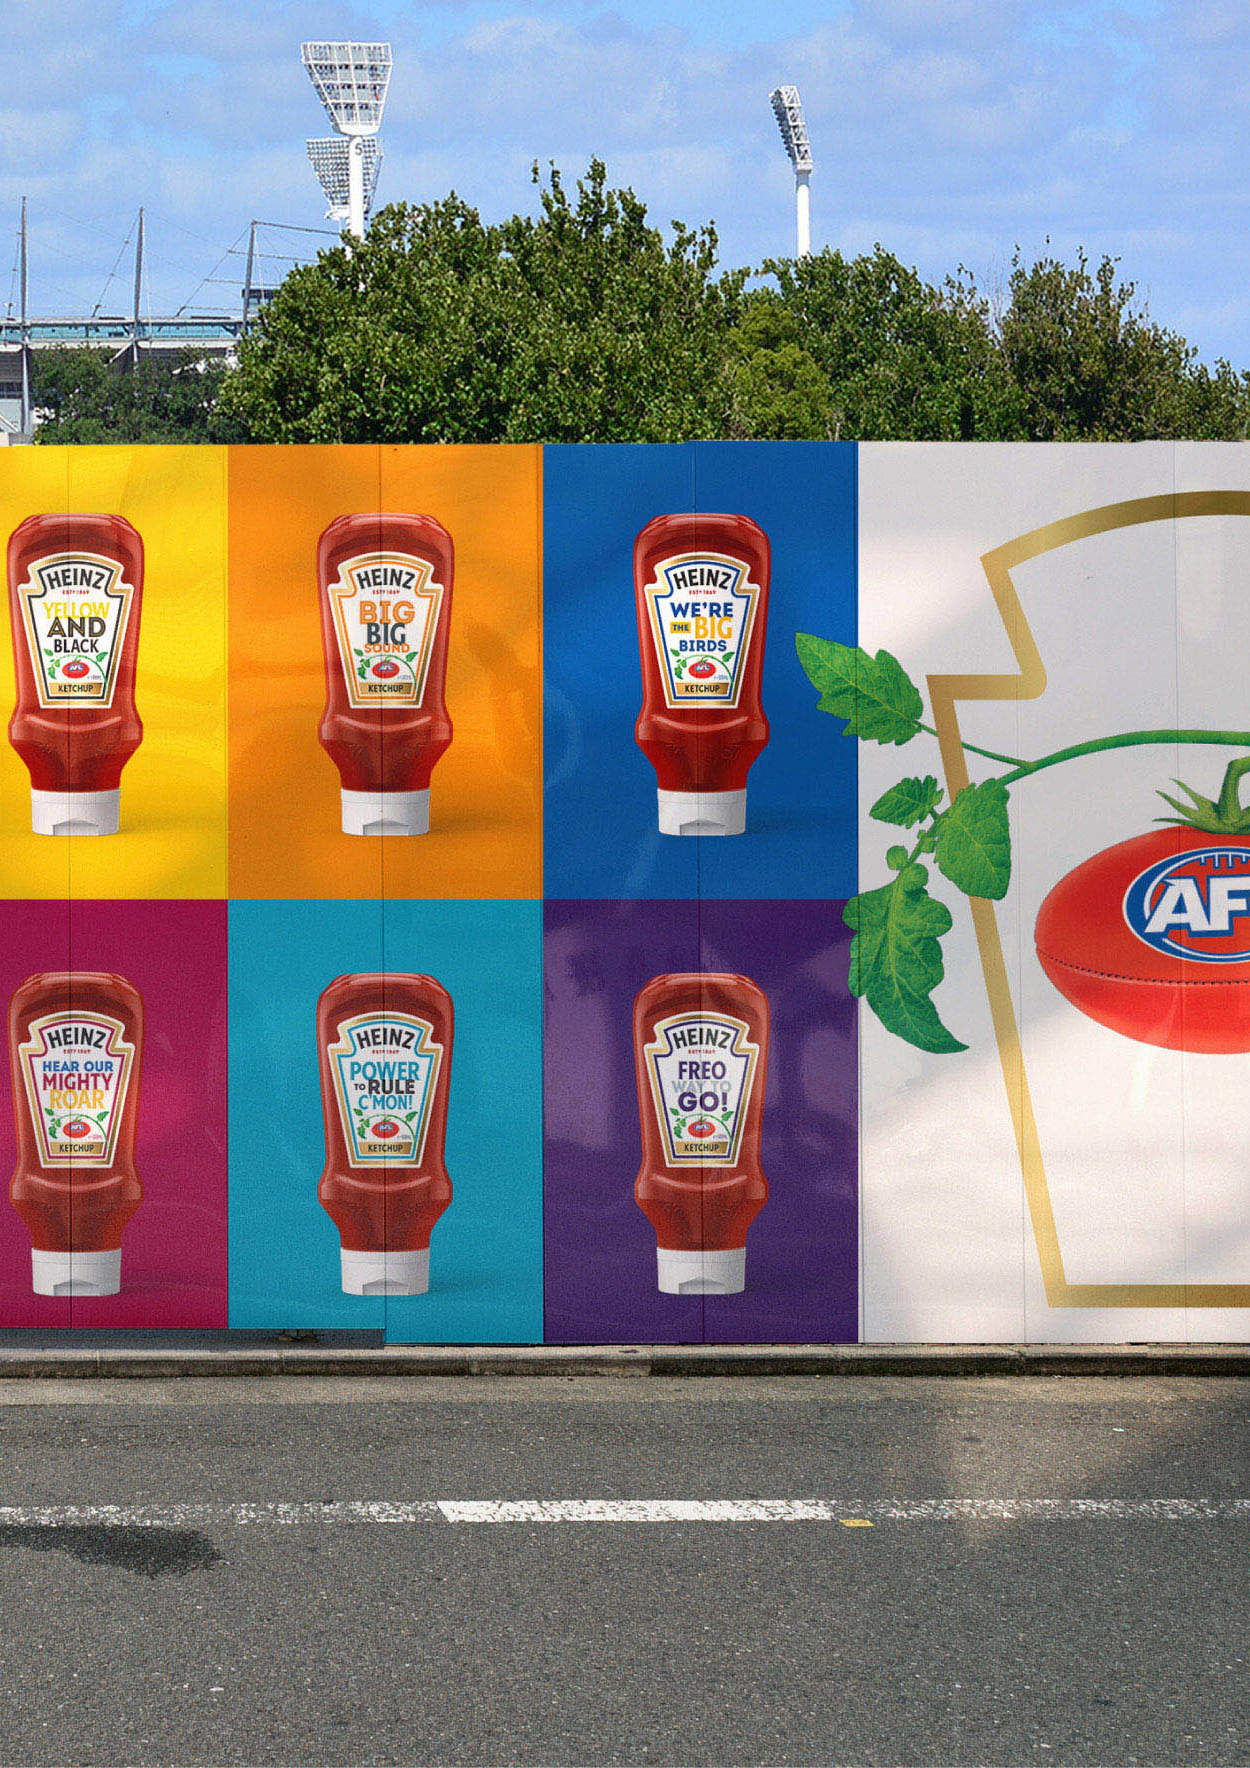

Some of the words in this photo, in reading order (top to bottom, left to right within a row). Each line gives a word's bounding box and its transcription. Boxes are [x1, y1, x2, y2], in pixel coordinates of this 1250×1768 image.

[355, 143, 363, 156] 5
[46, 568, 105, 589] HEINZ
[356, 568, 416, 589] HEINZ
[673, 568, 732, 589] HEINZ
[43, 602, 110, 619] YELLOW
[359, 601, 415, 624] BIG
[670, 602, 733, 618] WE'RE
[47, 617, 106, 637] AND
[367, 622, 406, 645] BIG
[695, 617, 732, 639] BIG
[54, 639, 99, 653] BLACK
[364, 643, 410, 653] SOUND
[679, 640, 727, 652] BIRDS
[1144, 877, 1250, 933] AF
[47, 1027, 106, 1049] HEINZ
[356, 1028, 415, 1049] HEINZ
[673, 1028, 731, 1049] HEINZ
[43, 1061, 79, 1072] HEAR
[84, 1061, 113, 1072] OUR
[350, 1062, 420, 1080] POWER
[678, 1061, 726, 1079] FREO
[43, 1073, 113, 1090] MIGHTY
[368, 1080, 415, 1094] RULE
[671, 1080, 706, 1093] WAY
[712, 1080, 732, 1093] TO
[50, 1089, 105, 1109] ROAR
[359, 1094, 412, 1110] C'MON!
[678, 1092, 727, 1112] GO!
[59, 1144, 94, 1152] KETCHUP
[684, 1144, 719, 1152] KETCHUP
